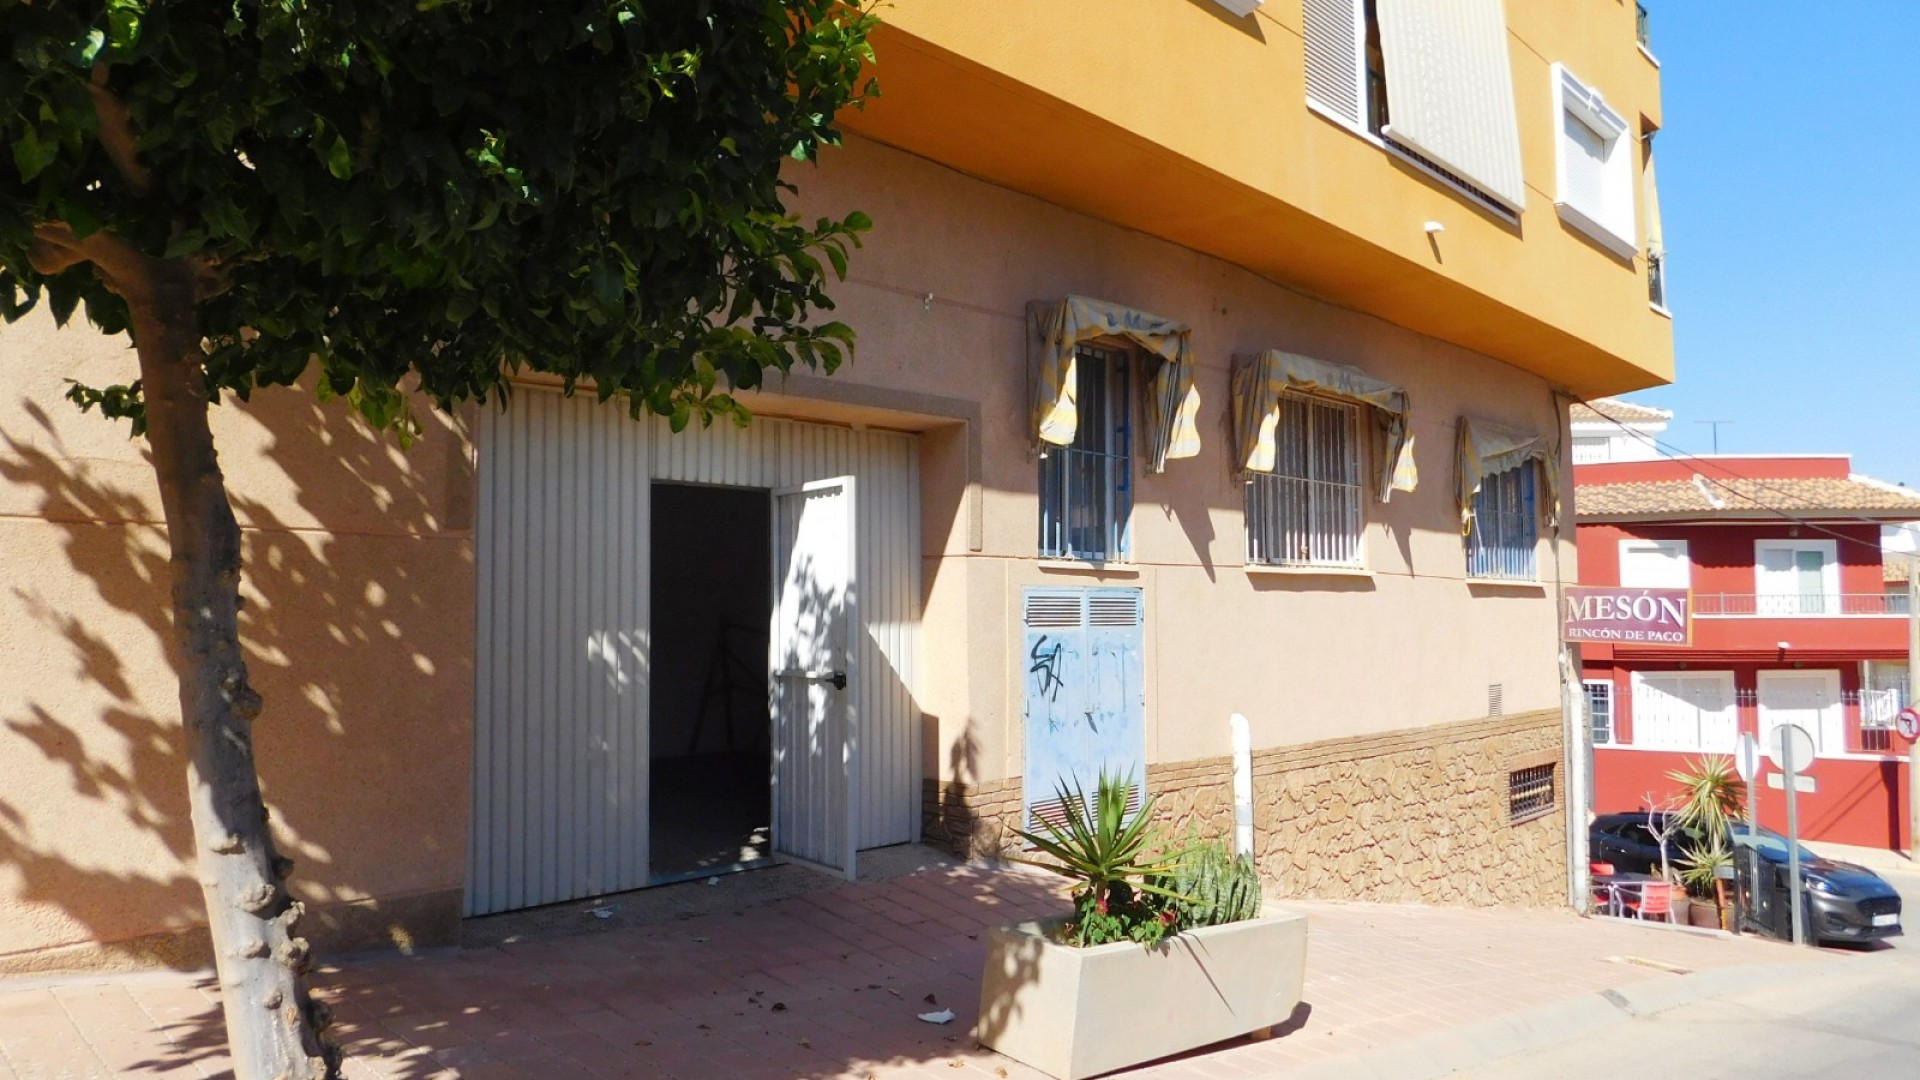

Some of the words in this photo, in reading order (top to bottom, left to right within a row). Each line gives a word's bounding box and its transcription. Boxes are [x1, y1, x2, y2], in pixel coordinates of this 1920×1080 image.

[1565, 590, 1687, 627] MESÓN
[1569, 627, 1621, 639] RINCÓN
[1625, 630, 1644, 640] DE
[1647, 631, 1683, 642] PACO
